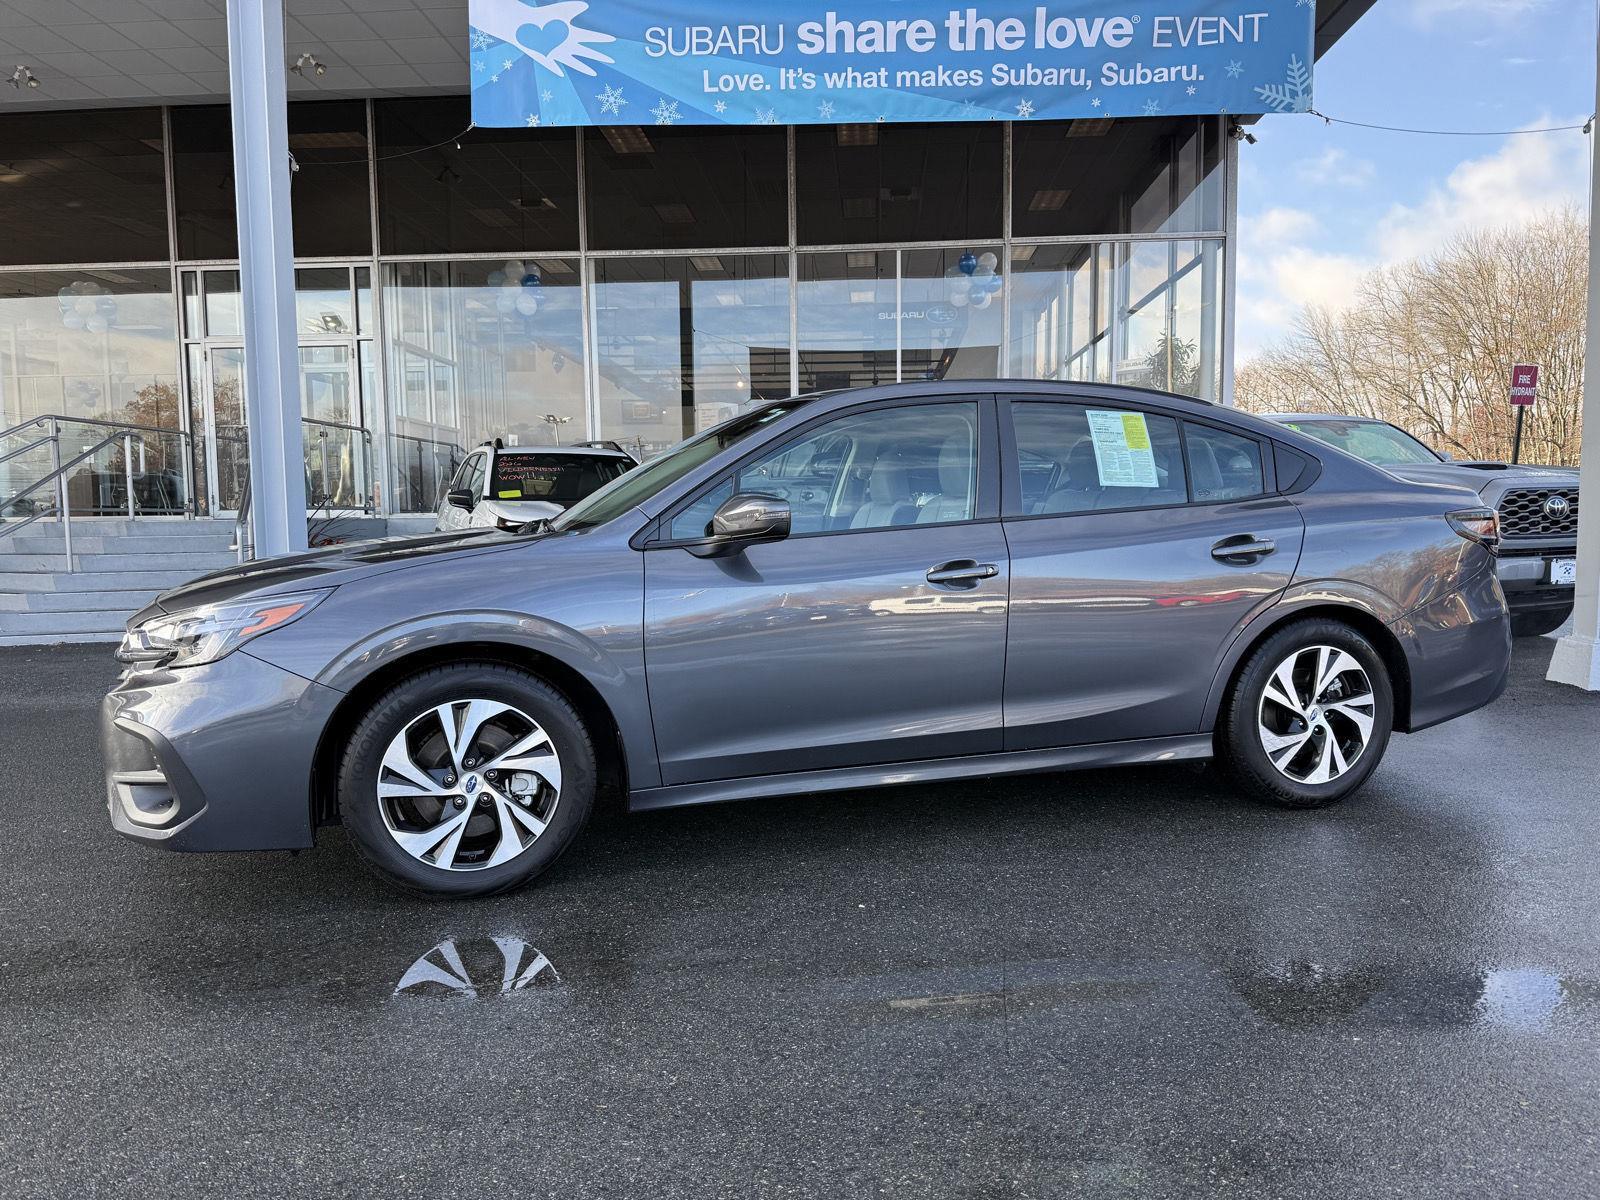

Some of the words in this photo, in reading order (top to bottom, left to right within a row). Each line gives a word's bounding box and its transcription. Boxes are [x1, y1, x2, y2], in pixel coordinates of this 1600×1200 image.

[645, 24, 784, 56] SUBARU
[797, 12, 936, 55] share
[944, 8, 1026, 51] the
[1152, 13, 1269, 47] EVENT
[703, 69, 771, 93] Love.
[824, 67, 888, 89] what
[897, 65, 983, 87] makes
[991, 63, 1092, 90] Subaru,
[1100, 62, 1204, 86] Subaru.
[1511, 386, 1536, 396] HYDRANT
[1518, 374, 1531, 384] FIRE
[350, 696, 413, 781] YOKOHAMA
